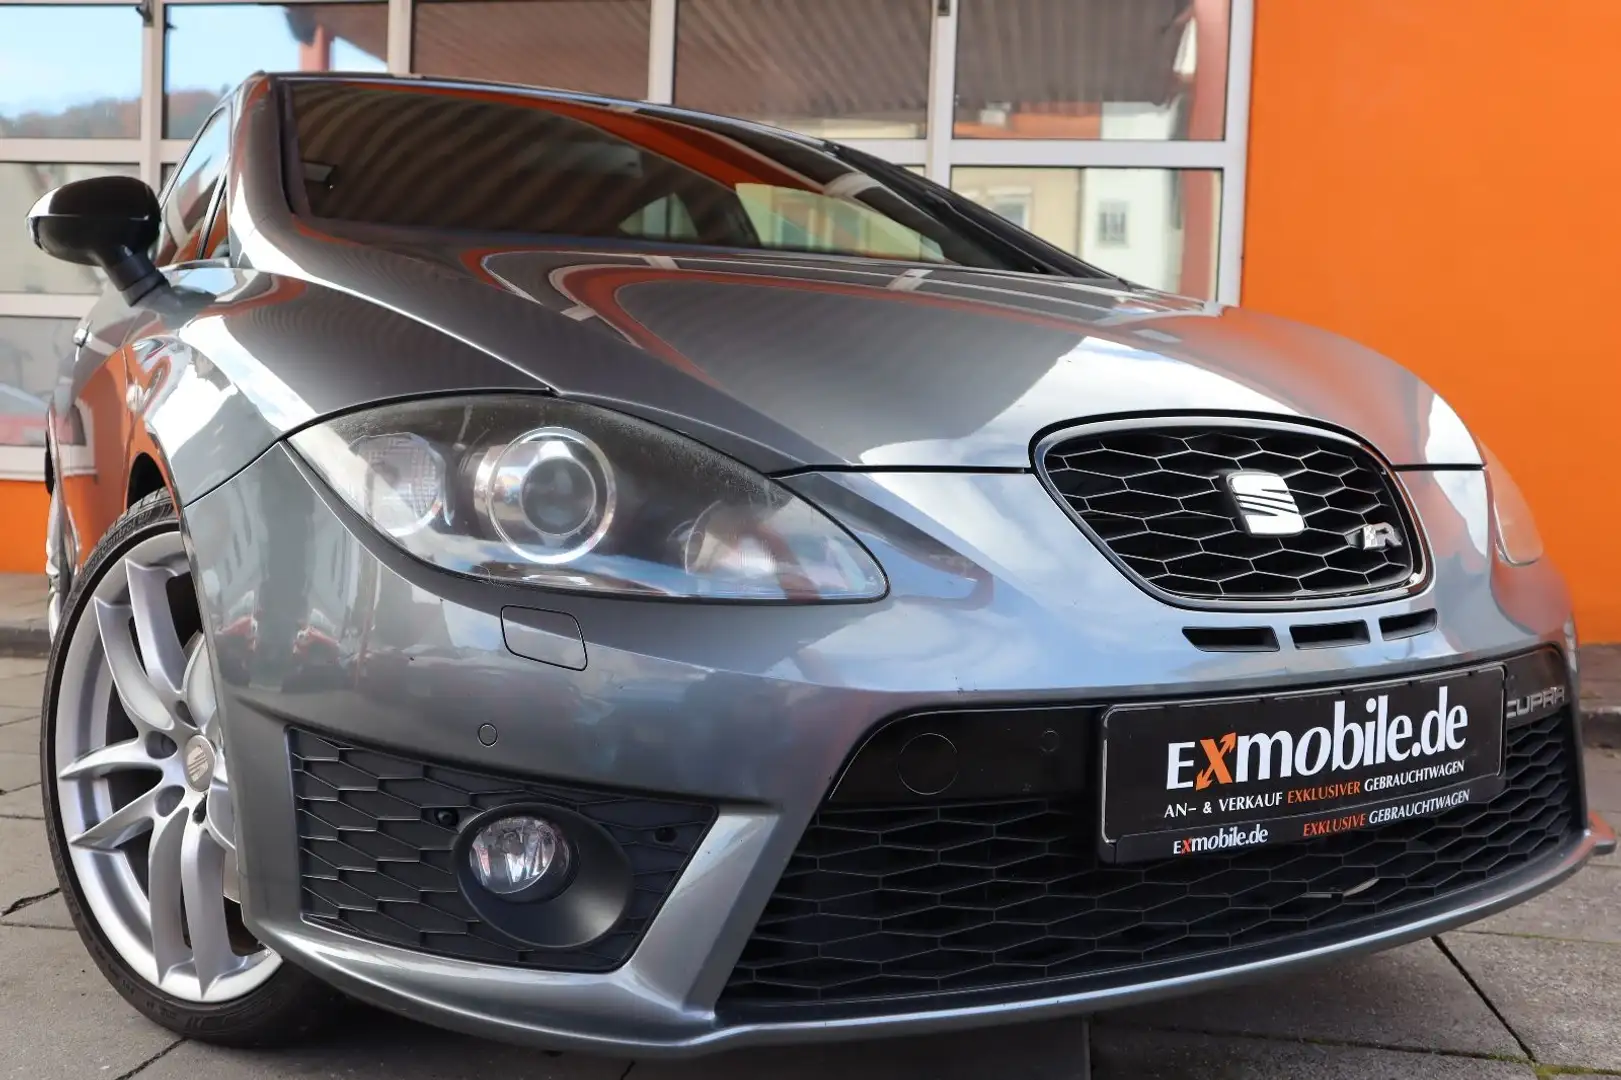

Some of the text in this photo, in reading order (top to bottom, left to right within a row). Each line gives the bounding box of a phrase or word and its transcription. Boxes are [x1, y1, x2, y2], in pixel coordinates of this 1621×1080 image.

[1164, 760, 1465, 818] AN- & VERKAUF EXKLUSIVER GEBRAUCHTWAGEN
[1303, 813, 1367, 837] EXKLUSIVE
[1369, 789, 1471, 824] GEBRAUCHTWAGEN
